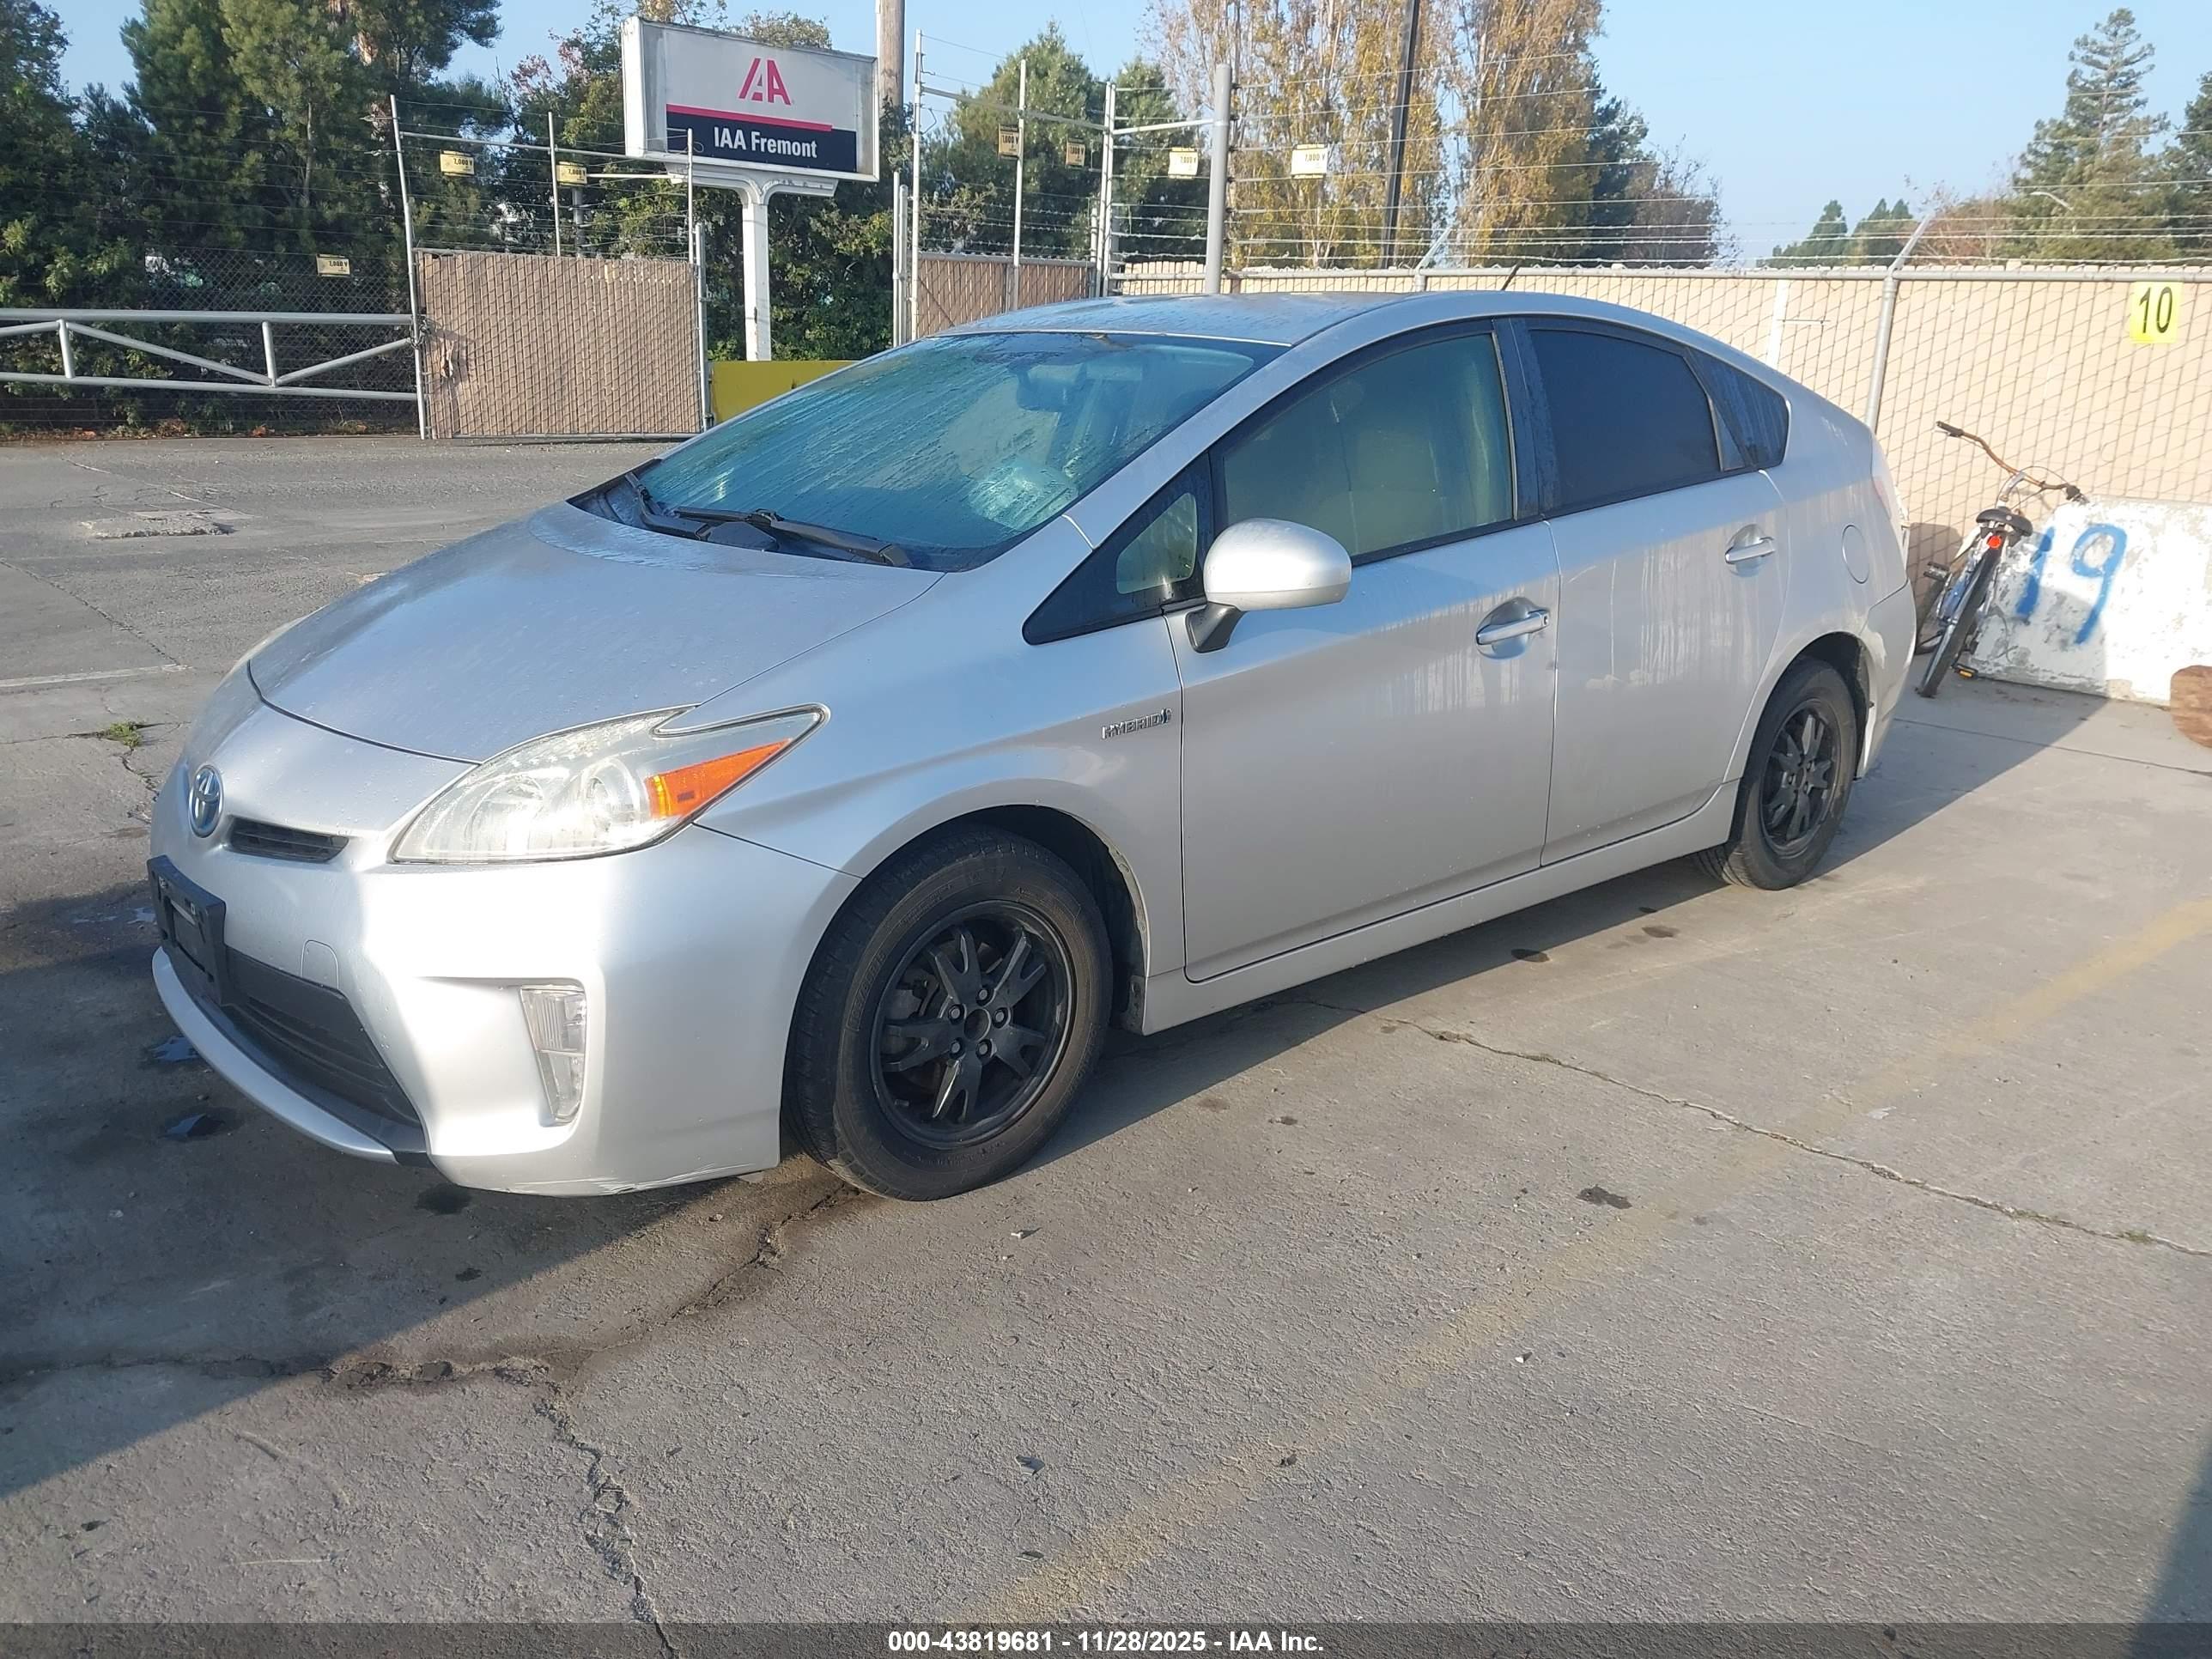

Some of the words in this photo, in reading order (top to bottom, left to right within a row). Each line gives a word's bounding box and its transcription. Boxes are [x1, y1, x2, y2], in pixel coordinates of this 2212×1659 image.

[714, 126, 747, 150] IAA
[750, 131, 817, 159] Fremont
[2139, 286, 2173, 334] 10
[2015, 523, 2127, 645] 19
[1102, 713, 1163, 740] HYBRID
